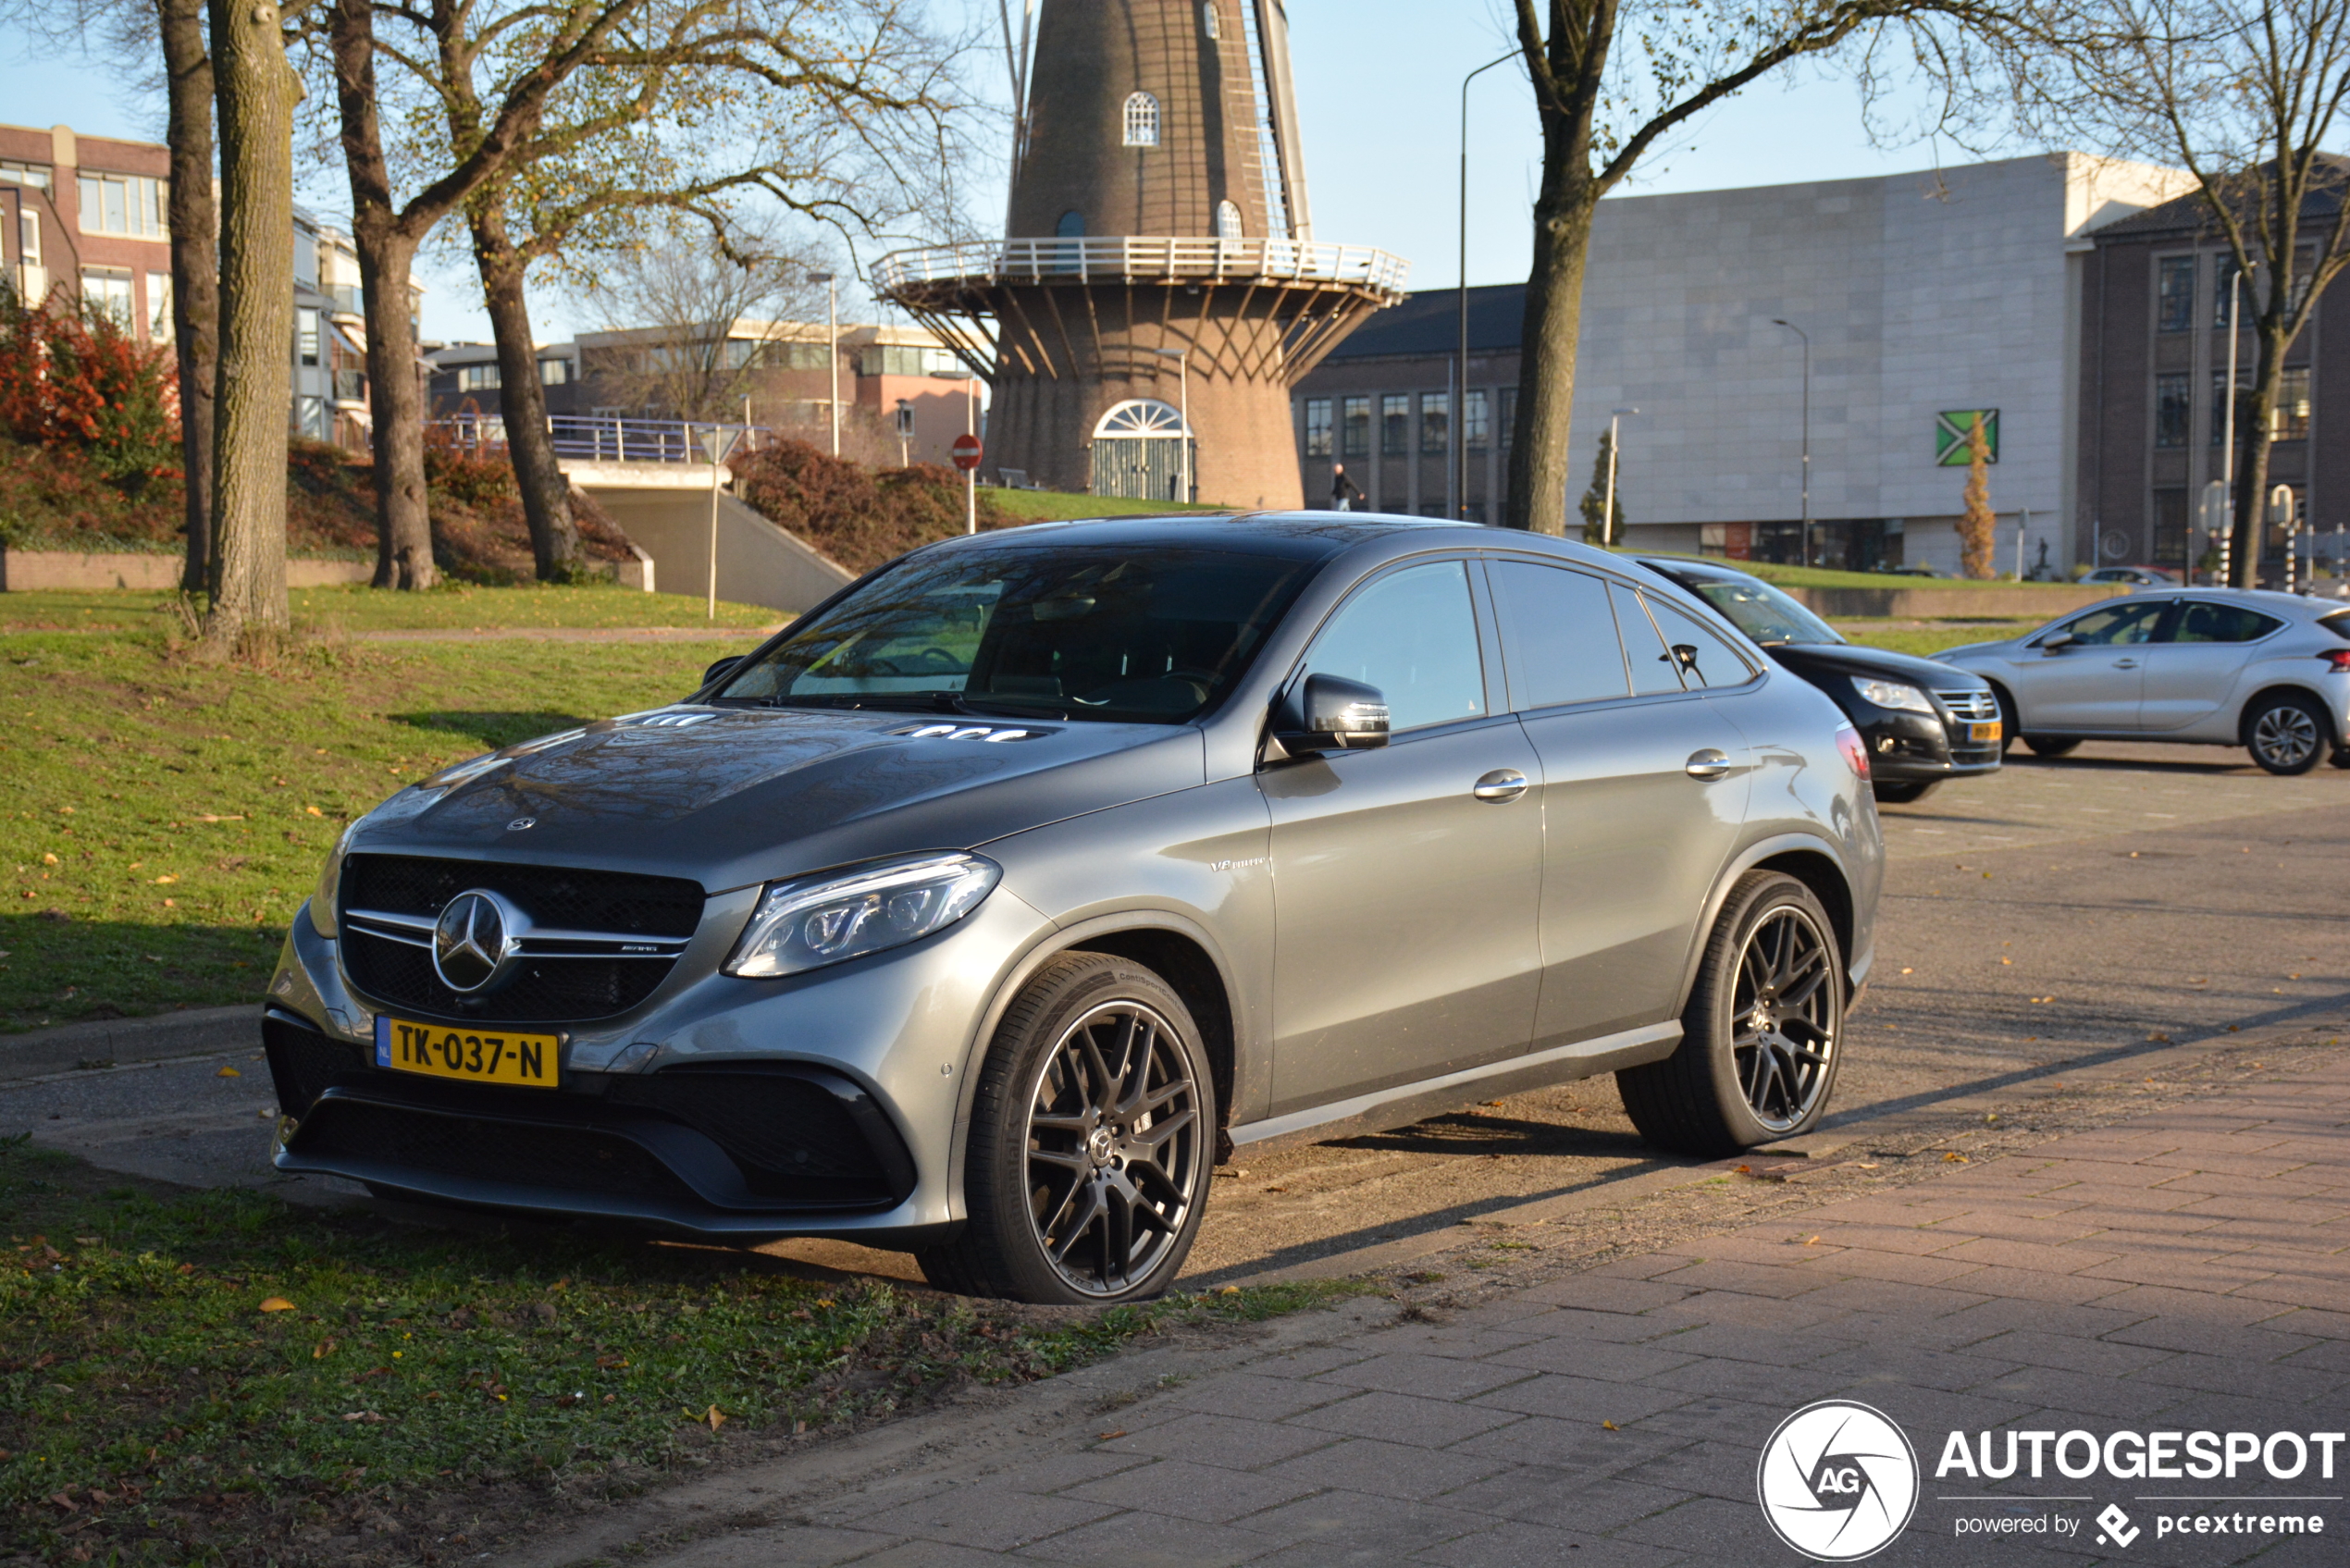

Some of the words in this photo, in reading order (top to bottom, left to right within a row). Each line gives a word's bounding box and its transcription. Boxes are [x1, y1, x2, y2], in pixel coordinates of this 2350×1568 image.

[1211, 859, 1231, 872] V8
[379, 1046, 390, 1058] NL
[398, 1024, 542, 1079] TK-037-N
